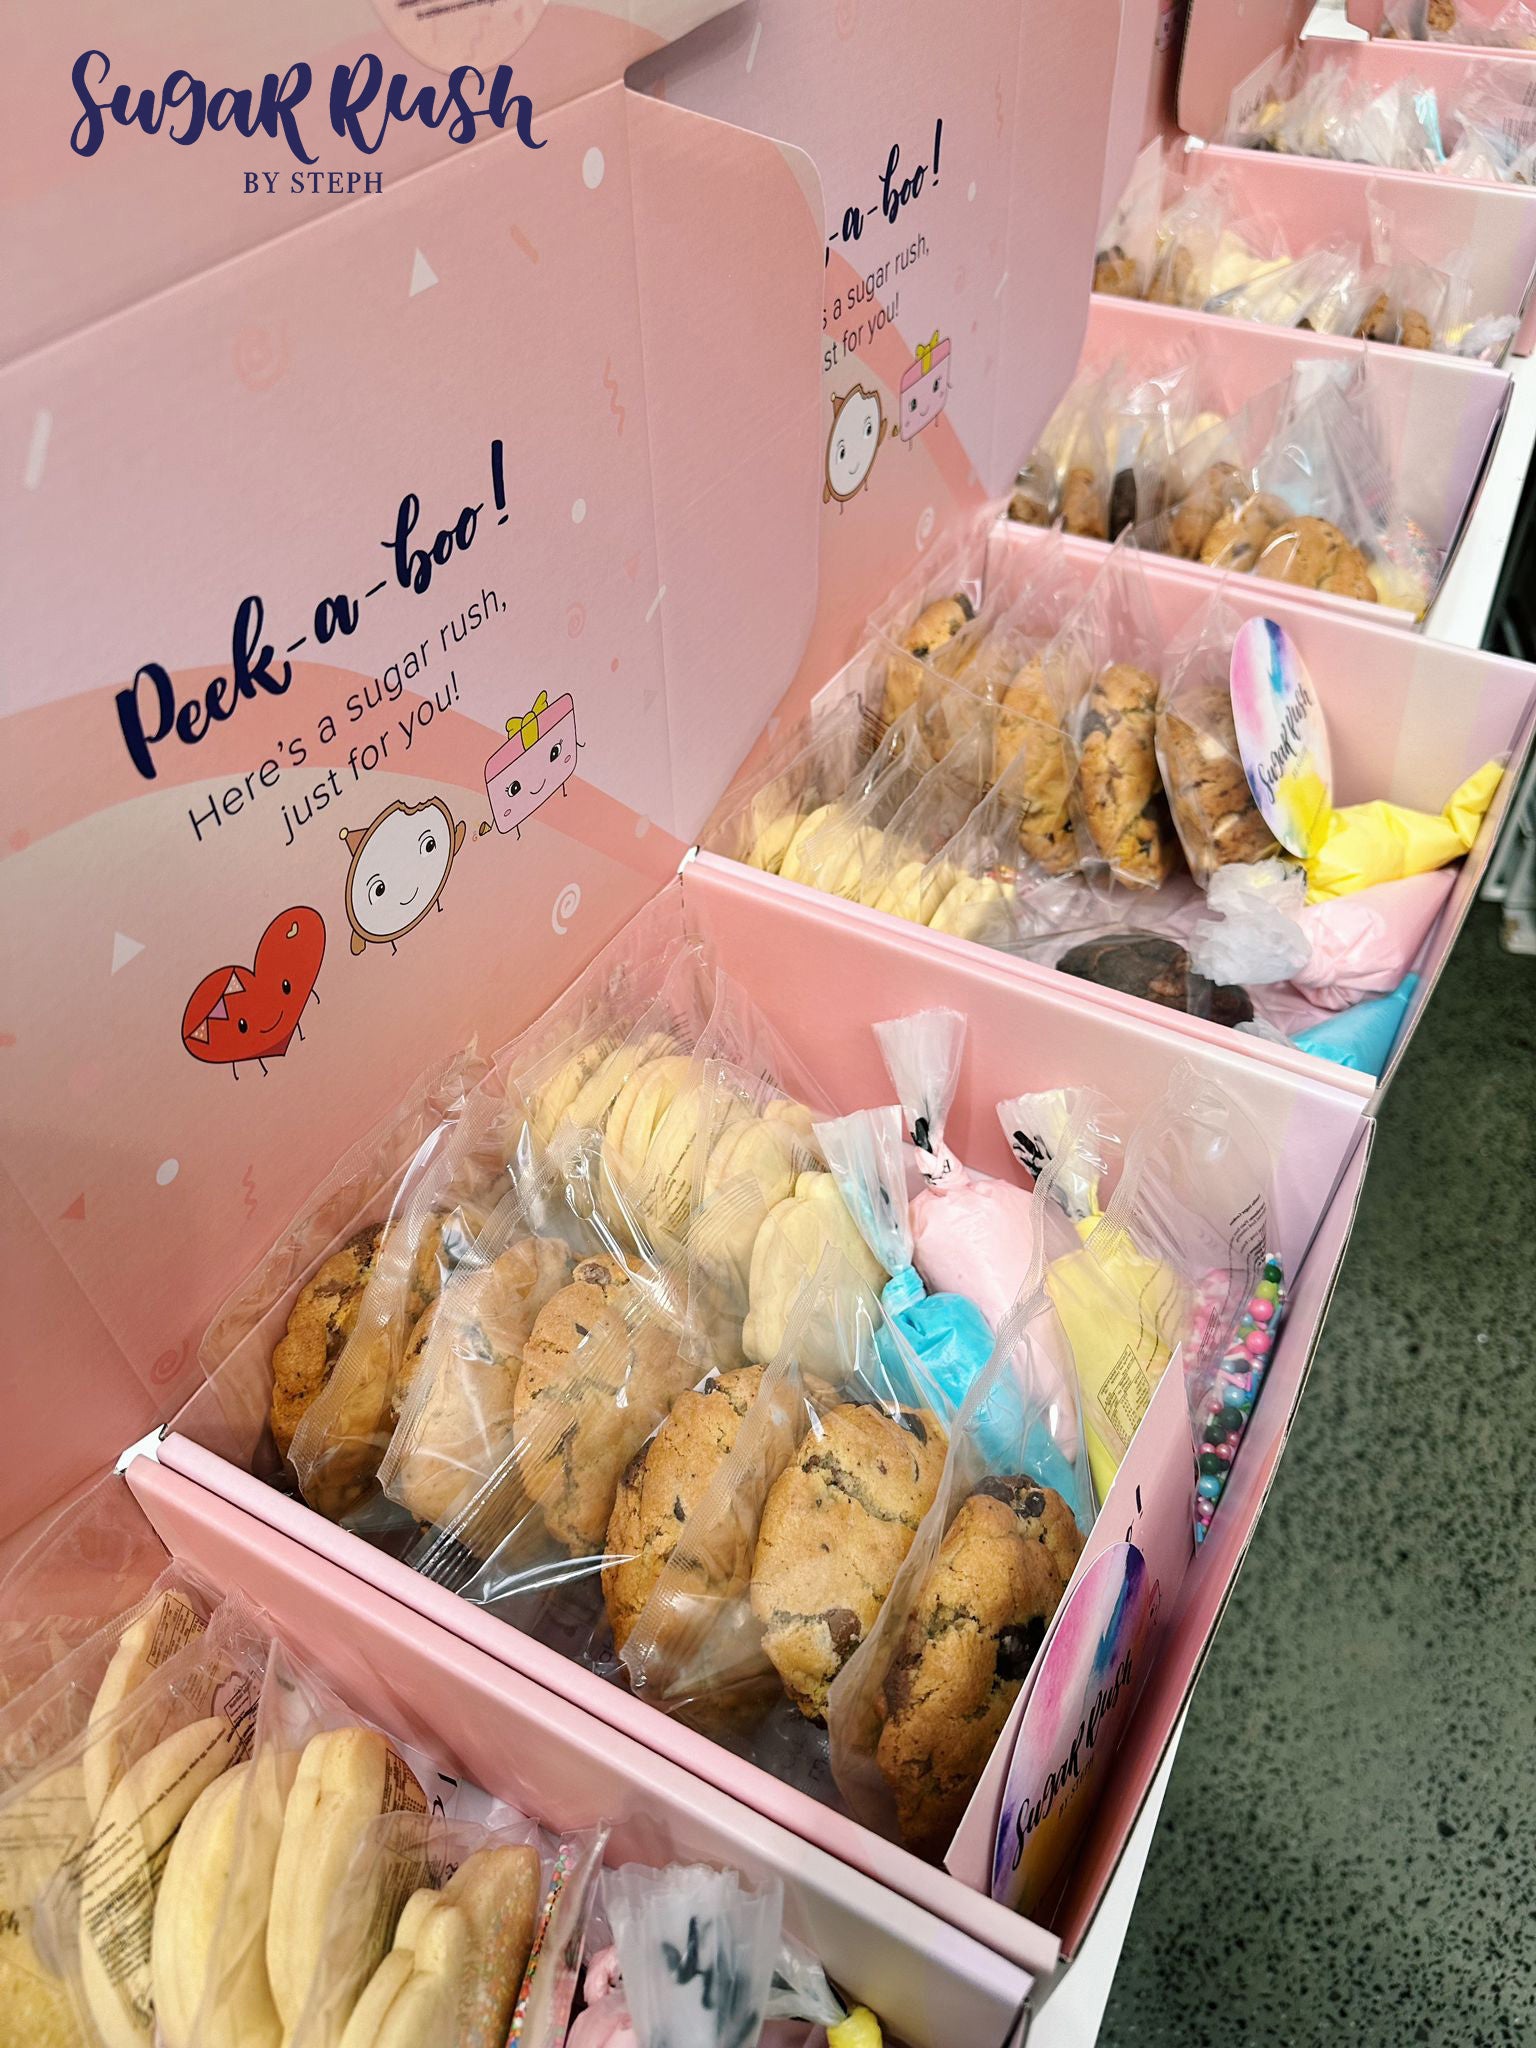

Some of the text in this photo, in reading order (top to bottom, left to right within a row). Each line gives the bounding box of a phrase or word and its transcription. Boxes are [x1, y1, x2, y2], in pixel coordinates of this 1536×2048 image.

[832, 298, 842, 321] a
[847, 260, 892, 311] sugar
[894, 232, 930, 276] rush,
[841, 324, 866, 358] for
[867, 291, 900, 345] you!
[114, 439, 509, 780] Peek-a-boo!
[187, 586, 508, 843] Here's a sugar rush,
[280, 670, 461, 847] just for you!
[1085, 1648, 1133, 1749] Rush
